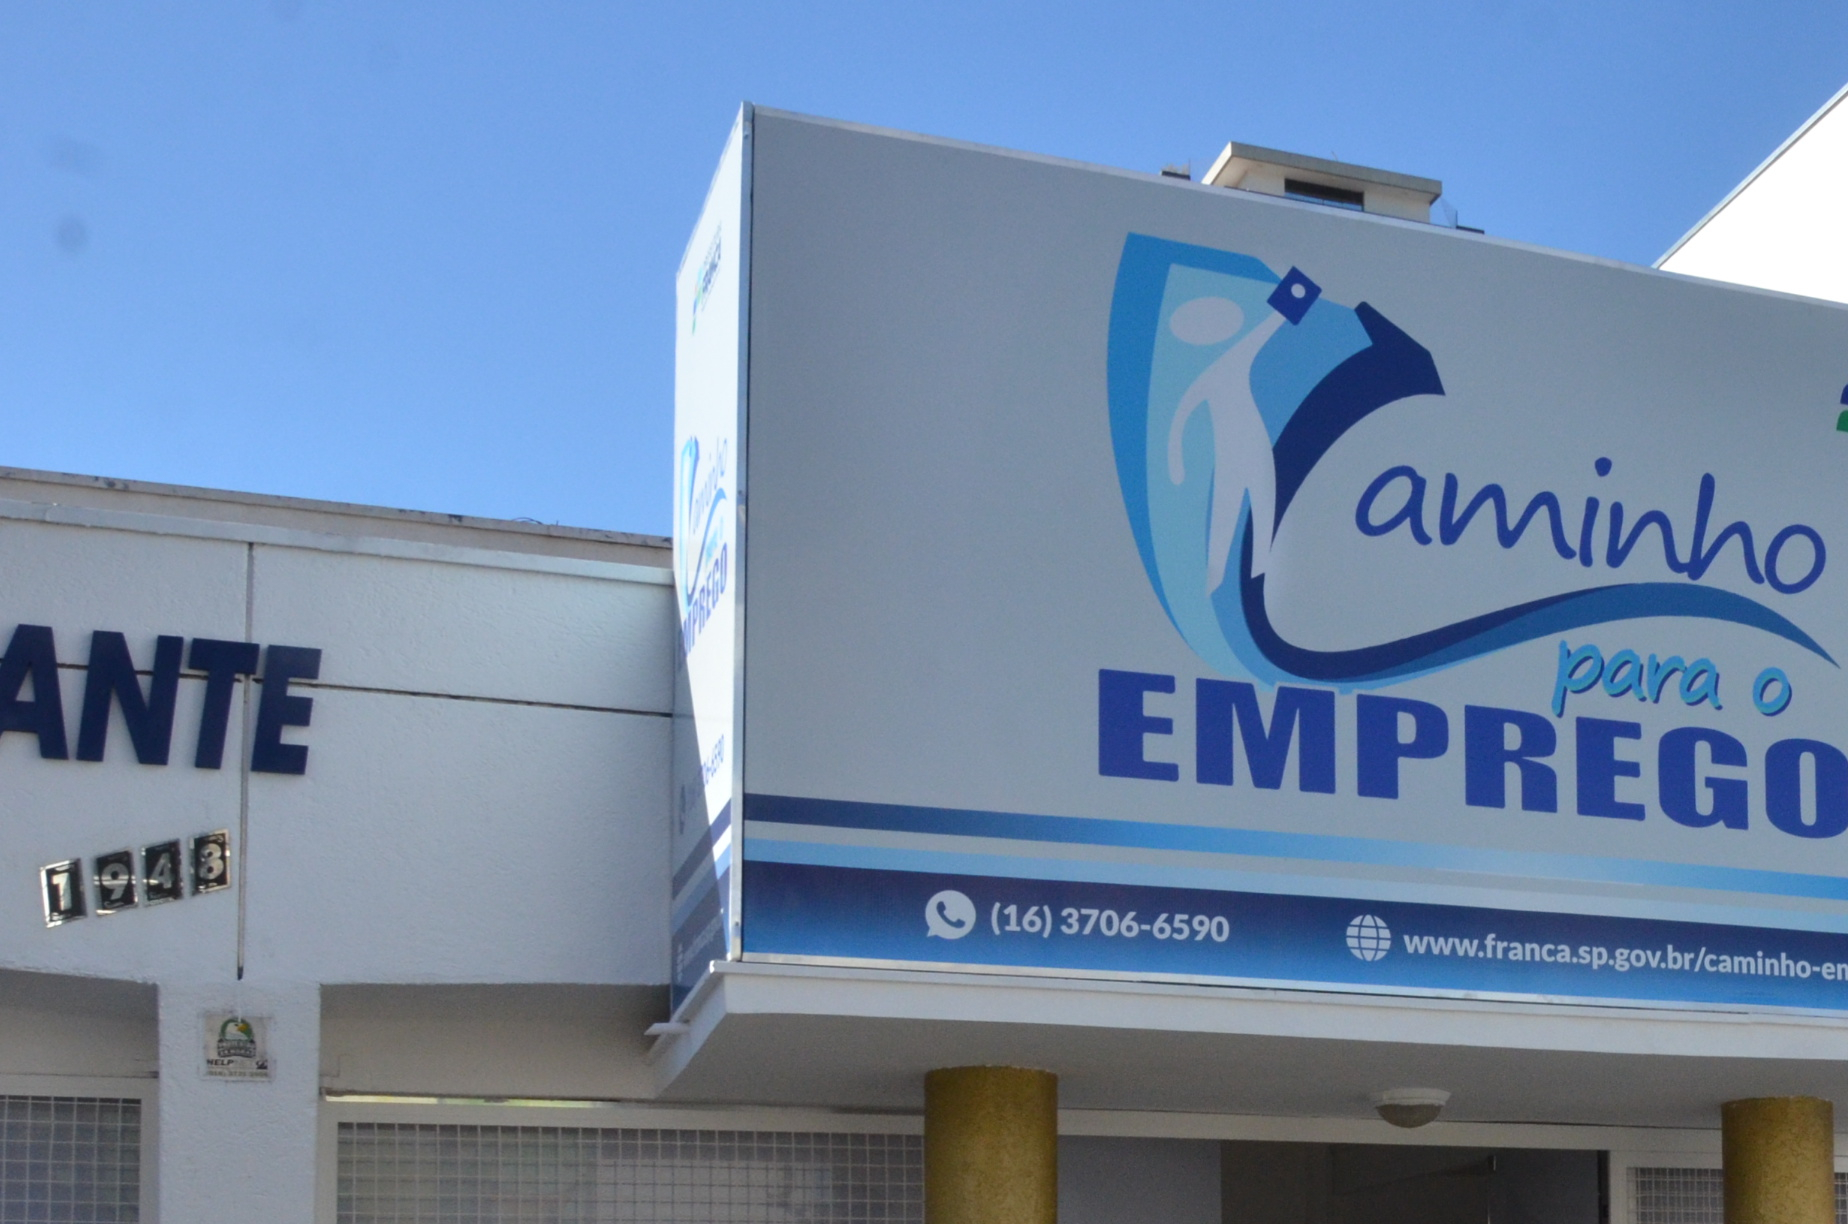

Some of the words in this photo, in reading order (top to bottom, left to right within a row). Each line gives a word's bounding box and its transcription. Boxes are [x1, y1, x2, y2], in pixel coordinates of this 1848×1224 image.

[0, 624, 322, 775] ANTE
[1552, 639, 1722, 717] para
[1752, 666, 1792, 717] o
[991, 902, 1052, 938] (16)
[1060, 907, 1230, 942] 3706-6590
